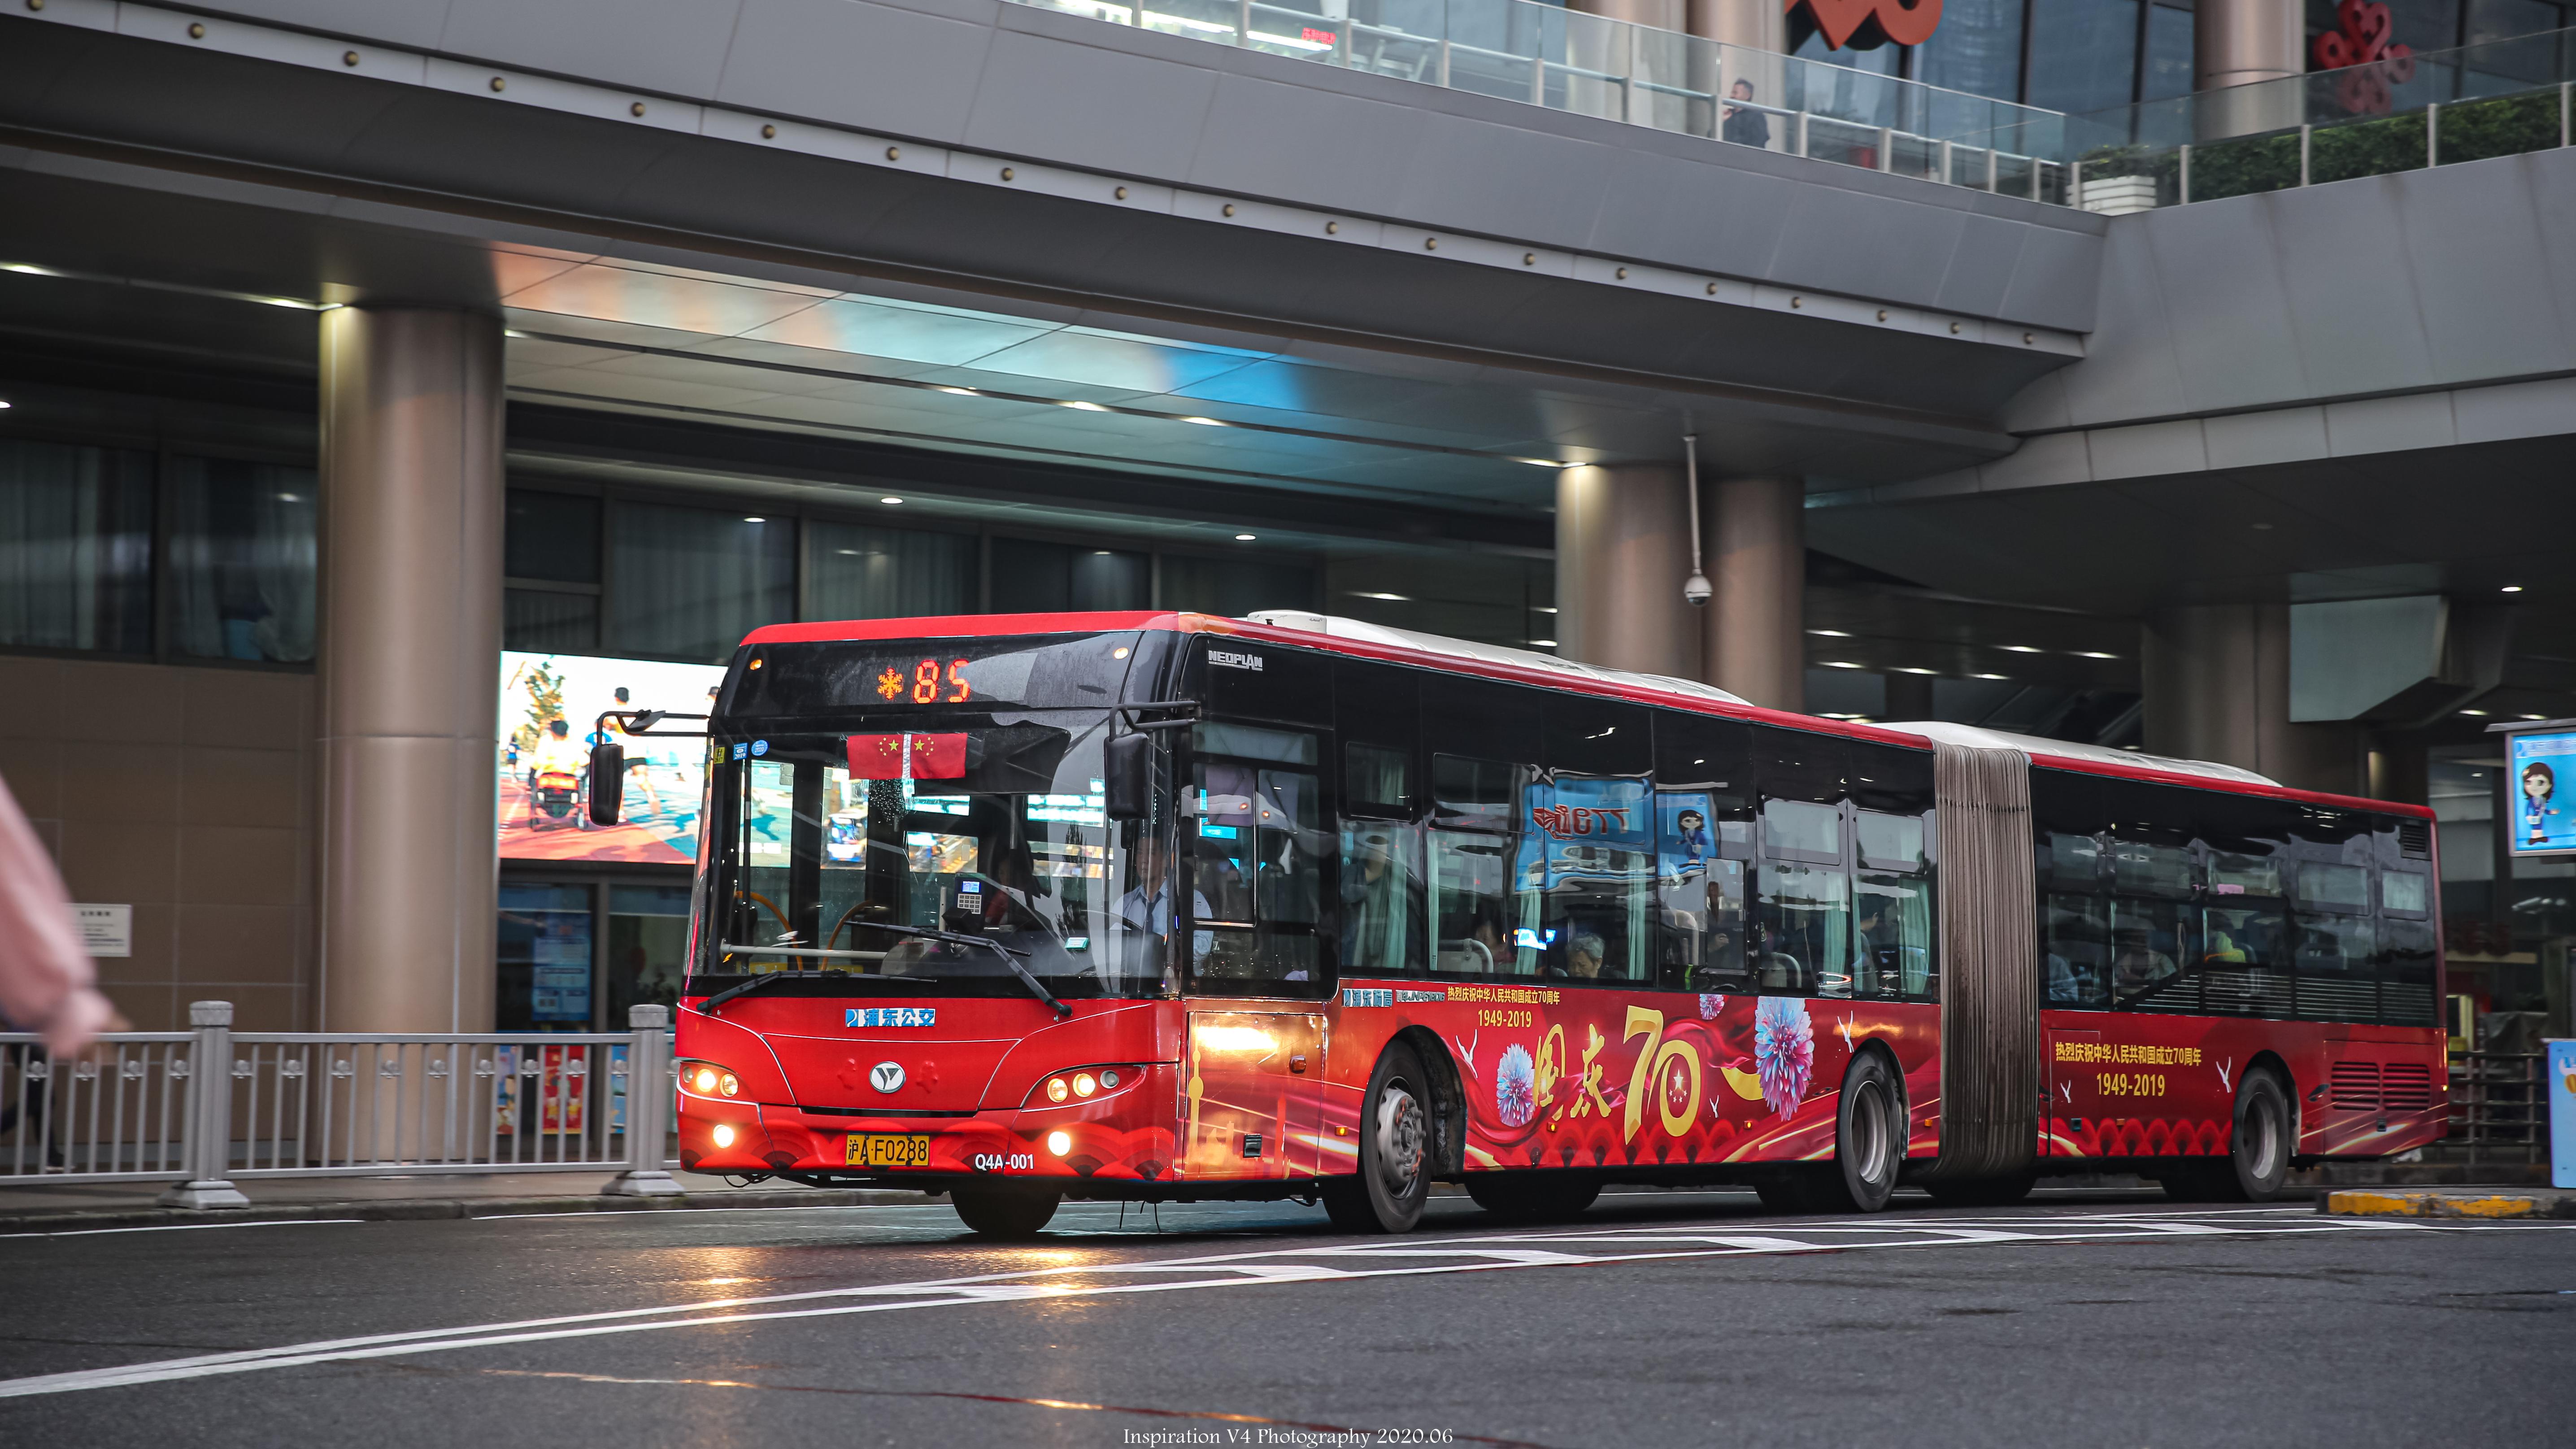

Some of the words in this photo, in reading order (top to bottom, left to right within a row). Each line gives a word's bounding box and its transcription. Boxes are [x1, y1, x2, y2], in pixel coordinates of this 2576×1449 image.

[1208, 650, 1262, 671] NEOPLAN
[914, 659, 970, 704] 85
[1448, 986, 1560, 1005] 热烈庆祝中华人民共和国成立70周年
[863, 1008, 935, 1027] 浦东公交
[1478, 1009, 1532, 1028] 1949-2019
[2055, 1042, 2202, 1066] 热烈庆祝中华人民共和国成立70周年
[1533, 1023, 1612, 1122] 国庆
[1623, 1005, 1701, 1146] 70
[2096, 1072, 2166, 1097] 1949-2019
[975, 1153, 1034, 1170] Q4A-001
